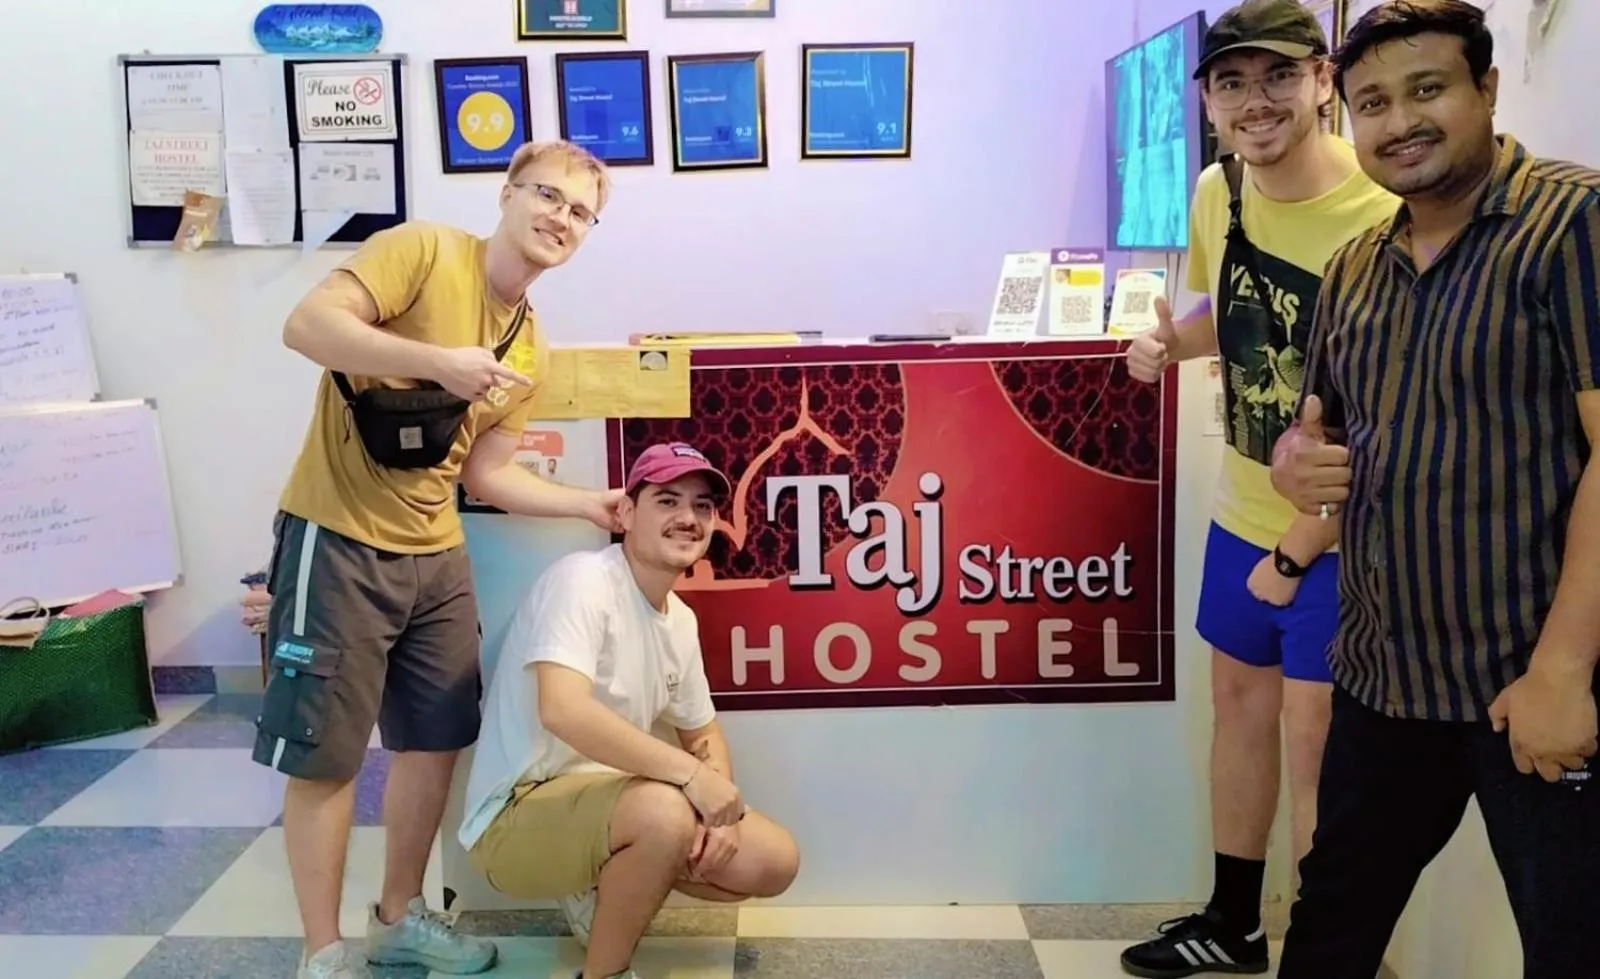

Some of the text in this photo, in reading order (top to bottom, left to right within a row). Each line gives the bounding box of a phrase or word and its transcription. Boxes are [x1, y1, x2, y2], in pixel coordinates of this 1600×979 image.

[306, 79, 351, 97] Please
[335, 101, 357, 113] NO
[311, 114, 382, 128] SMOKING
[465, 113, 505, 134] 9.9
[877, 121, 897, 136] 9.1
[766, 472, 1134, 614] Taj Street
[730, 617, 1141, 687] HOSTEL
